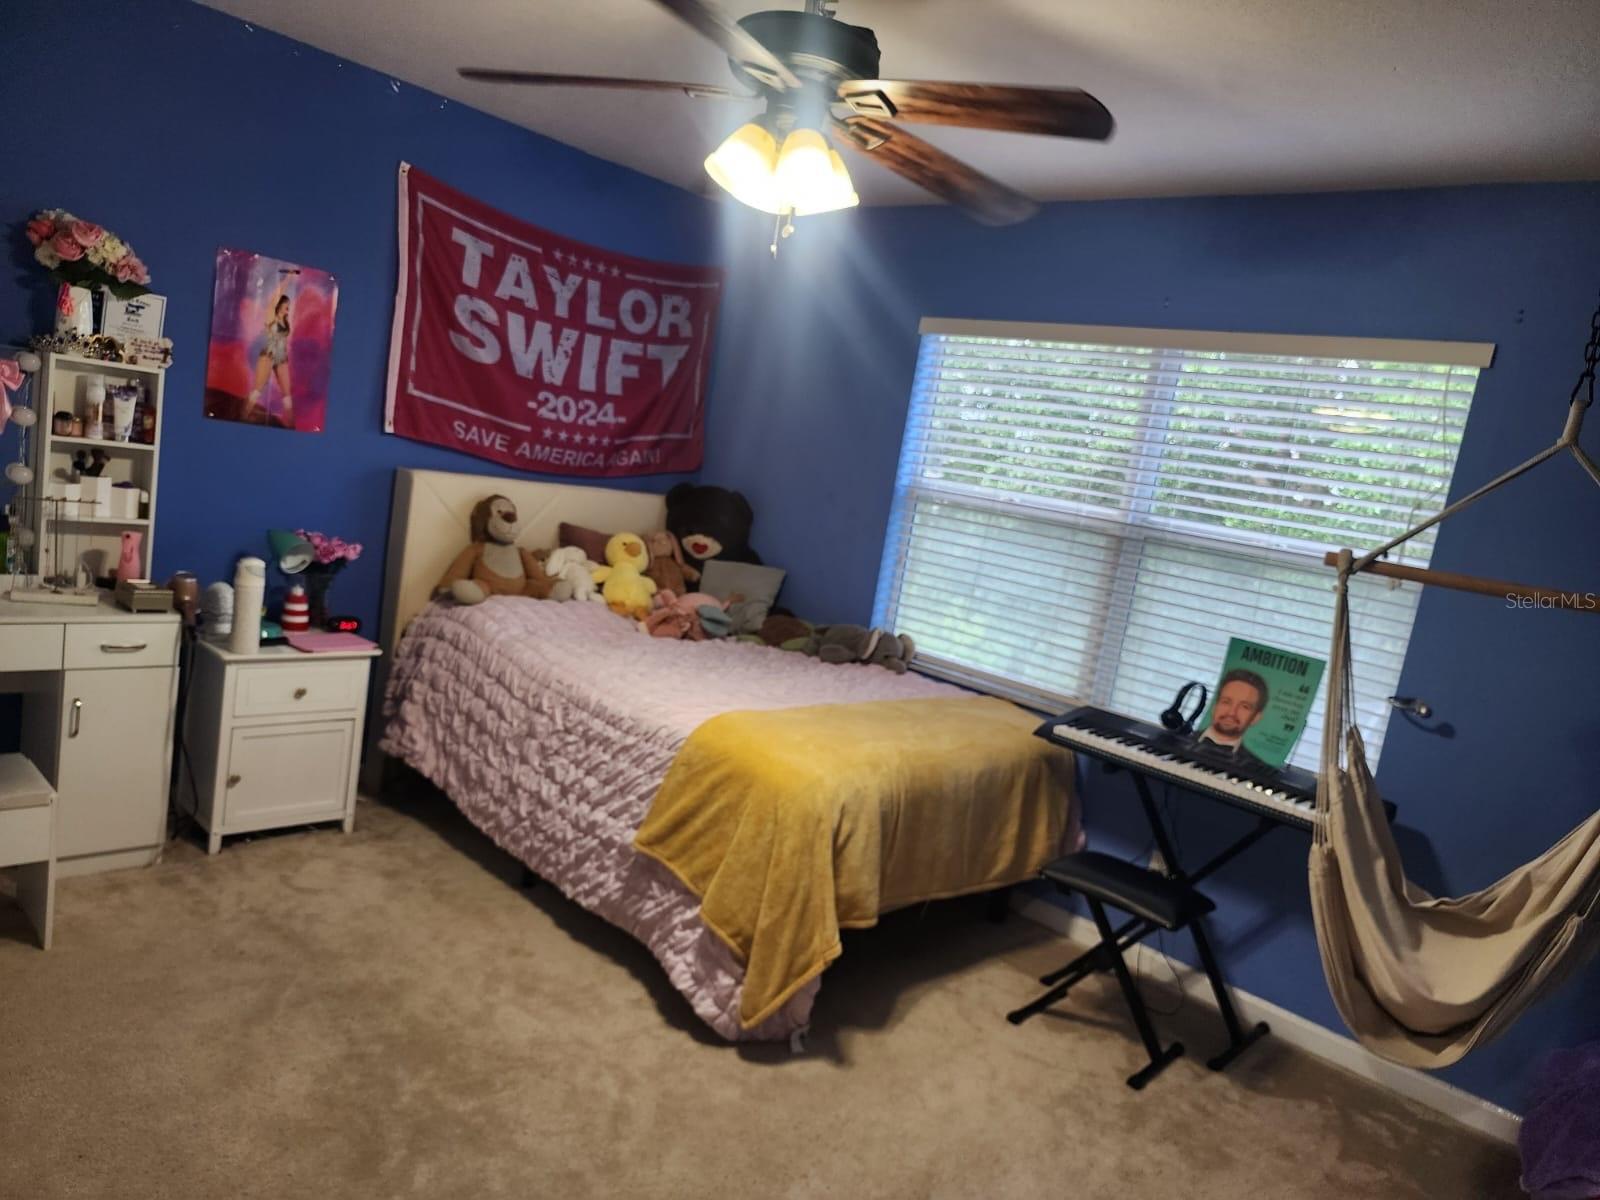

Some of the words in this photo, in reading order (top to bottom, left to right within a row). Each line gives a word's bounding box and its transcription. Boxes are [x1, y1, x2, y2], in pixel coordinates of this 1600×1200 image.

[451, 226, 693, 338] TAYLOR
[450, 294, 690, 396] SWIFT
[453, 421, 511, 452] SAVE
[515, 441, 605, 468] AMERICA
[1240, 646, 1310, 677] AMBITION
